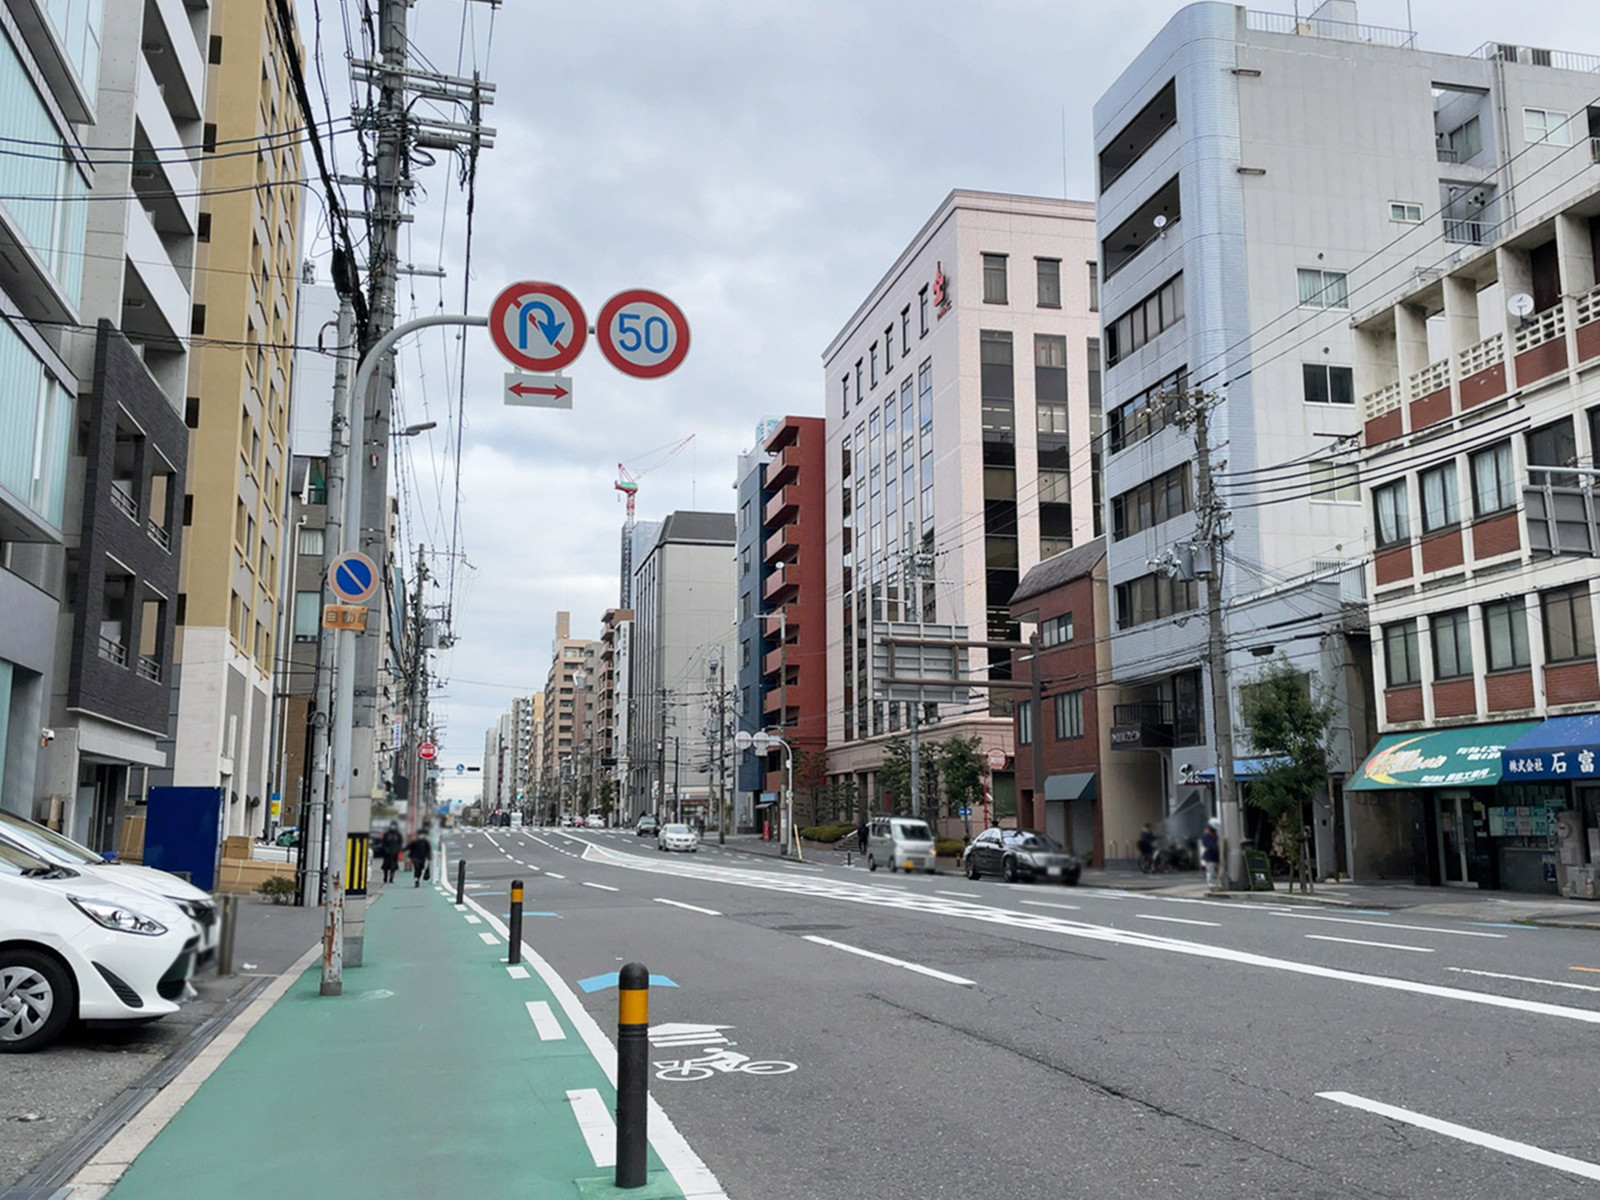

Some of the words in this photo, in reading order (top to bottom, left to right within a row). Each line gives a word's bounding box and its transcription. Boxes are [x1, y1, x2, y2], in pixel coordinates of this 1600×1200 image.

[619, 313, 668, 354] 50
[1508, 757, 1544, 773] 株式会社
